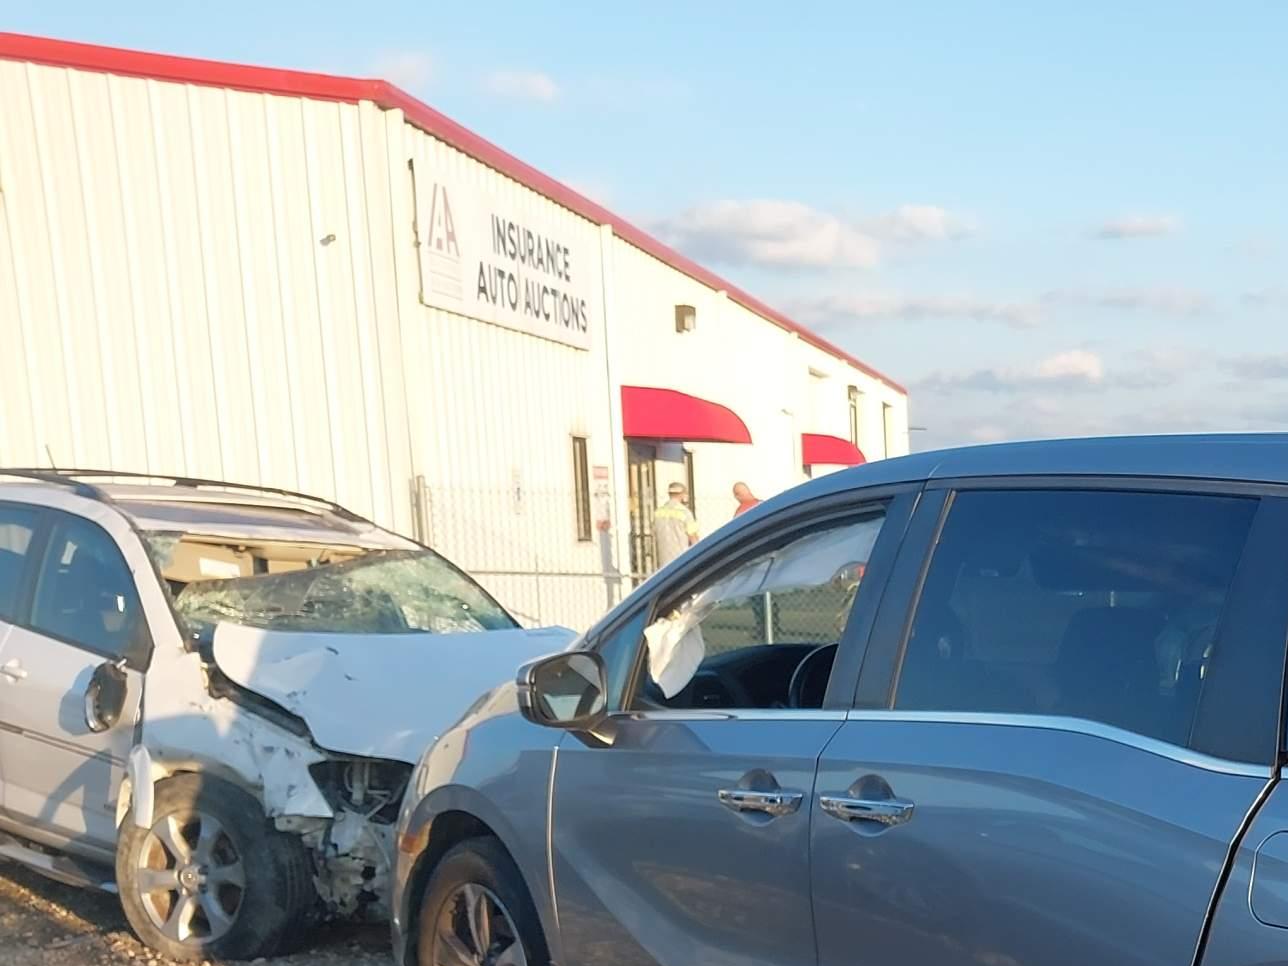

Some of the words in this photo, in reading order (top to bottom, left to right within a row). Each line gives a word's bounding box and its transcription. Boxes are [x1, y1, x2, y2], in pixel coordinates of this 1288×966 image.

[491, 213, 571, 282] INSURANCE
[477, 261, 518, 312] AUTO
[524, 278, 588, 333] AUCTIONS
